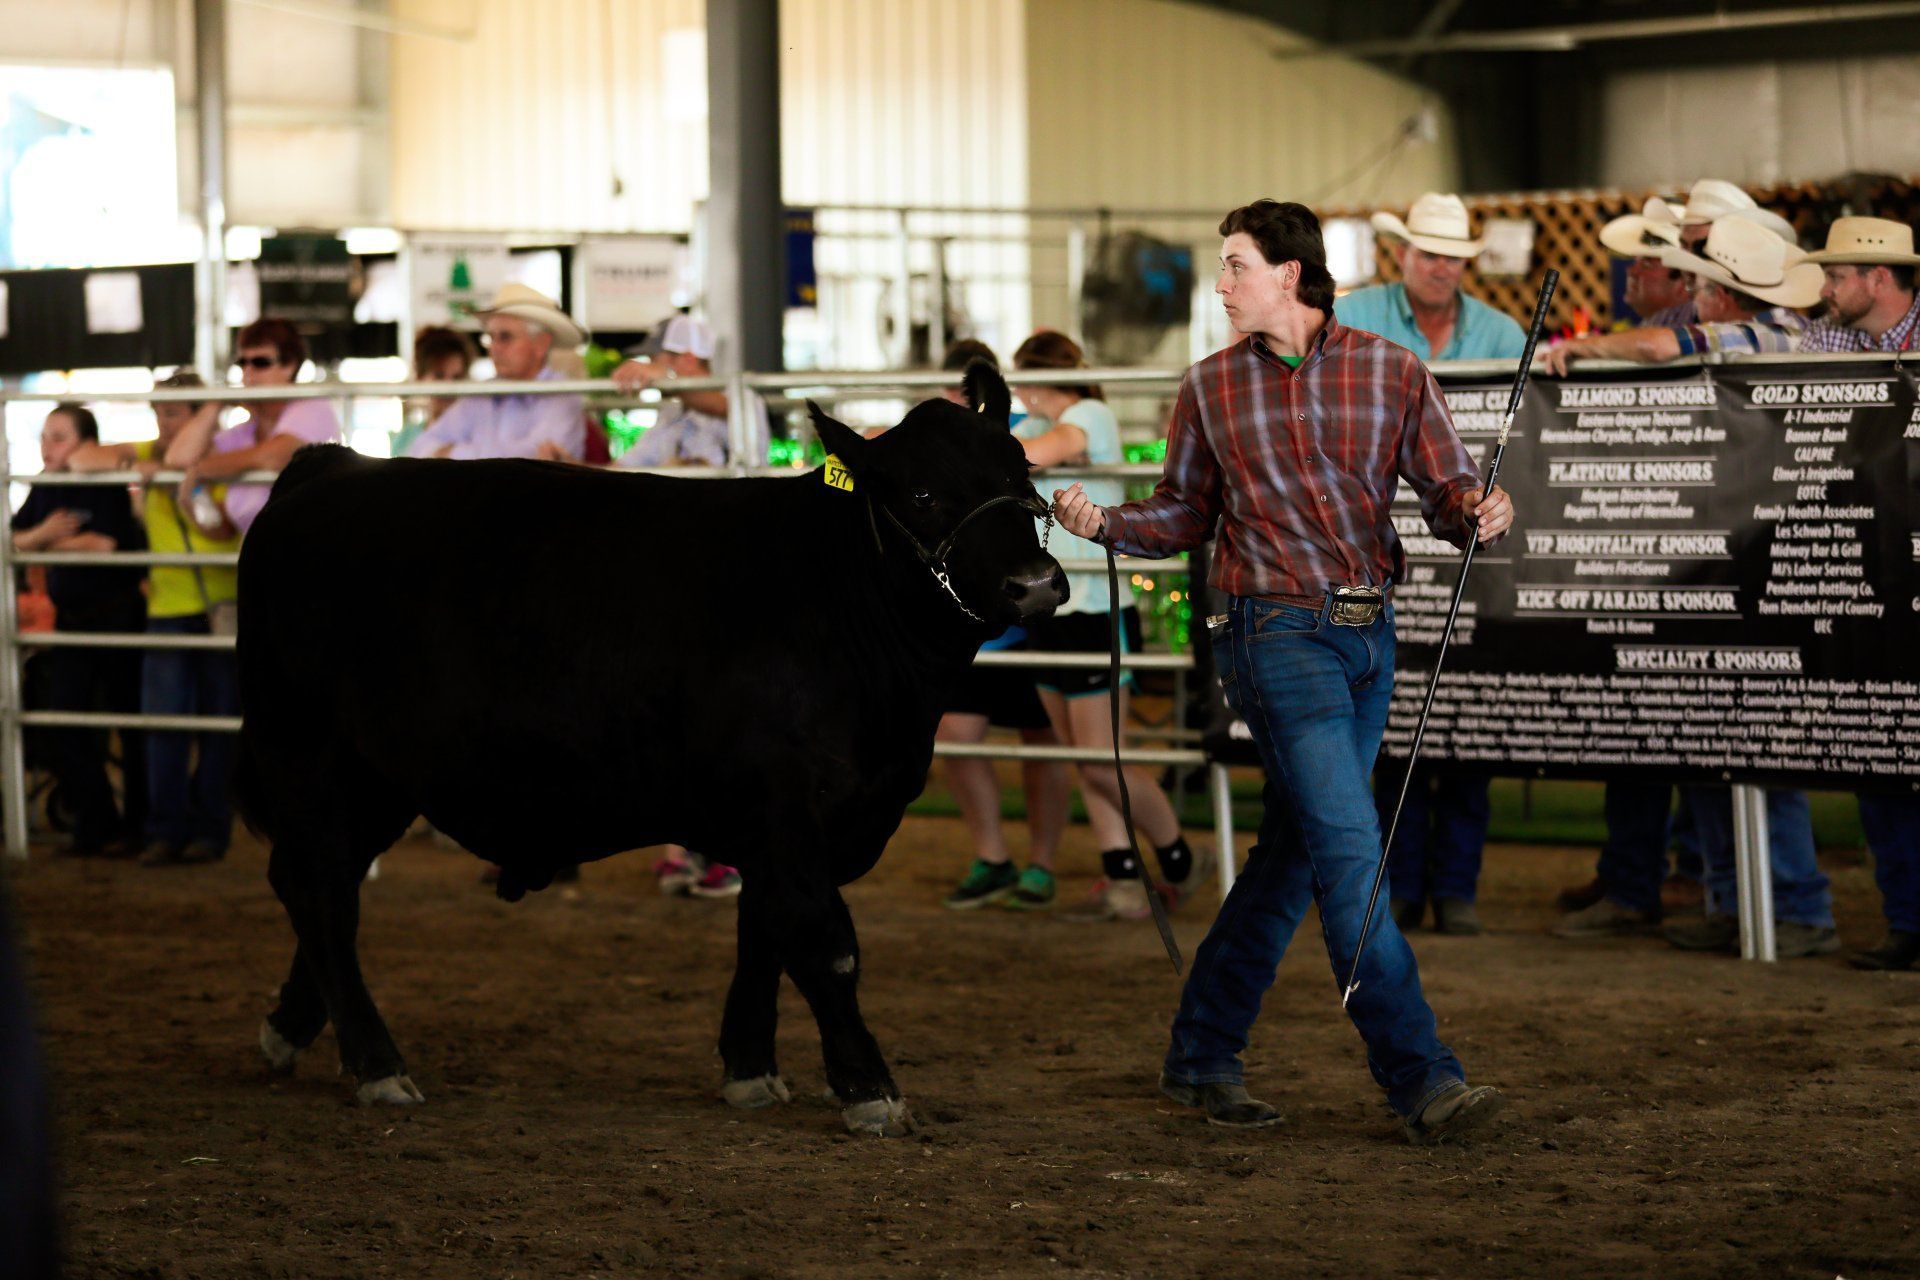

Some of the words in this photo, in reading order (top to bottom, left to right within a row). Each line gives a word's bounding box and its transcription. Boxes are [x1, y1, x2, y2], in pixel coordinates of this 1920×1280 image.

[1561, 388, 1636, 407] DIAMOND
[1638, 386, 1717, 405] SPONSORS
[1751, 385, 1799, 404] GOLD
[1801, 383, 1889, 403] SPONSORS
[1615, 413, 1651, 430] Oregon
[1783, 409, 1803, 423] A-1
[1803, 408, 1853, 424] Industrial
[1540, 428, 1591, 443] Hermiston
[1670, 428, 1694, 445] Jeep
[1694, 427, 1702, 442] &
[1785, 428, 1821, 443] Banner
[1822, 427, 1848, 443] Bank
[1794, 446, 1835, 463] CALPINE
[829, 466, 849, 489] 577
[1549, 462, 1631, 482] PLATINUM
[1634, 462, 1713, 482] SPONSORS
[1772, 466, 1806, 482] Elmer's
[1806, 466, 1854, 484] Irrigation
[1796, 485, 1828, 501] EOTEC
[1753, 504, 1786, 523] Family
[1787, 504, 1822, 520] Health
[1823, 504, 1875, 520] Associates
[1775, 524, 1791, 539] Les
[1793, 523, 1831, 539] Schwab
[1832, 524, 1857, 539] Tires
[1526, 536, 1554, 554] VIP
[1556, 536, 1657, 555] HOSPITALITY
[1659, 536, 1728, 555] SPONSOR
[1770, 543, 1811, 560] Midway
[1812, 543, 1829, 558] Bar
[1830, 543, 1839, 558] &
[1841, 542, 1863, 558] Grill
[1793, 561, 1823, 577] Labor
[1824, 561, 1863, 577] Services
[1766, 580, 1817, 596] Pendleton
[1818, 581, 1858, 599] Bottling
[1859, 581, 1875, 597] Co.
[1592, 591, 1660, 611] PARADE
[1662, 591, 1737, 611] SPONSOR
[1757, 599, 1779, 615] Tom
[1780, 599, 1820, 616] Denchel
[1821, 600, 1844, 616] Ford
[1845, 600, 1885, 619] Country
[1586, 619, 1615, 634] Ranch
[1617, 619, 1625, 634] &
[1626, 619, 1655, 635] Home
[1813, 618, 1833, 635] UEC
[1616, 650, 1709, 670] SPECIALTY
[1714, 651, 1802, 671] SPONSORS
[1610, 676, 1641, 689] Benton
[1643, 677, 1679, 690] Franklin
[1680, 678, 1696, 691] Fair
[1698, 678, 1705, 691] &
[1707, 678, 1735, 691] Rodeo
[1742, 679, 1784, 693] Bonney's
[1785, 679, 1797, 693] Ag
[1799, 679, 1806, 692] &
[1807, 679, 1828, 693] Auto
[1829, 680, 1858, 695] Repair
[1865, 680, 1890, 694] Brian
[1891, 681, 1918, 695] Blake
[1630, 692, 1671, 706] Columbia
[1672, 693, 1706, 706] Harvest
[1707, 694, 1734, 707] Foods
[1742, 694, 1801, 710] Cunningham
[1802, 695, 1829, 711] Sheep
[1834, 696, 1868, 710] Eastern
[1869, 697, 1903, 713] Oregon
[1637, 707, 1683, 722] Hermiston
[1684, 708, 1726, 722] Chamber
[1727, 708, 1735, 722] of
[1737, 709, 1785, 723] Commerce
[1790, 709, 1811, 725] High
[1812, 711, 1870, 726] Performance
[1871, 712, 1895, 728] Signs
[1625, 723, 1656, 738] County
[1657, 723, 1675, 736] Fair
[1681, 723, 1717, 738] Morrow
[1718, 725, 1748, 740] County
[1749, 725, 1766, 738] FFA
[1767, 725, 1806, 742] Chapters
[1811, 726, 1835, 741] Nash
[1835, 727, 1888, 744] Contracting
[1702, 739, 1710, 753] &
[1770, 740, 1801, 755] Robert
[1847, 743, 1897, 760] Equipment
[1629, 752, 1681, 766] Association
[1752, 755, 1783, 769] United
[1783, 756, 1817, 771] Rentals
[1822, 757, 1841, 772] U.S.
[1841, 758, 1865, 774] Navy
